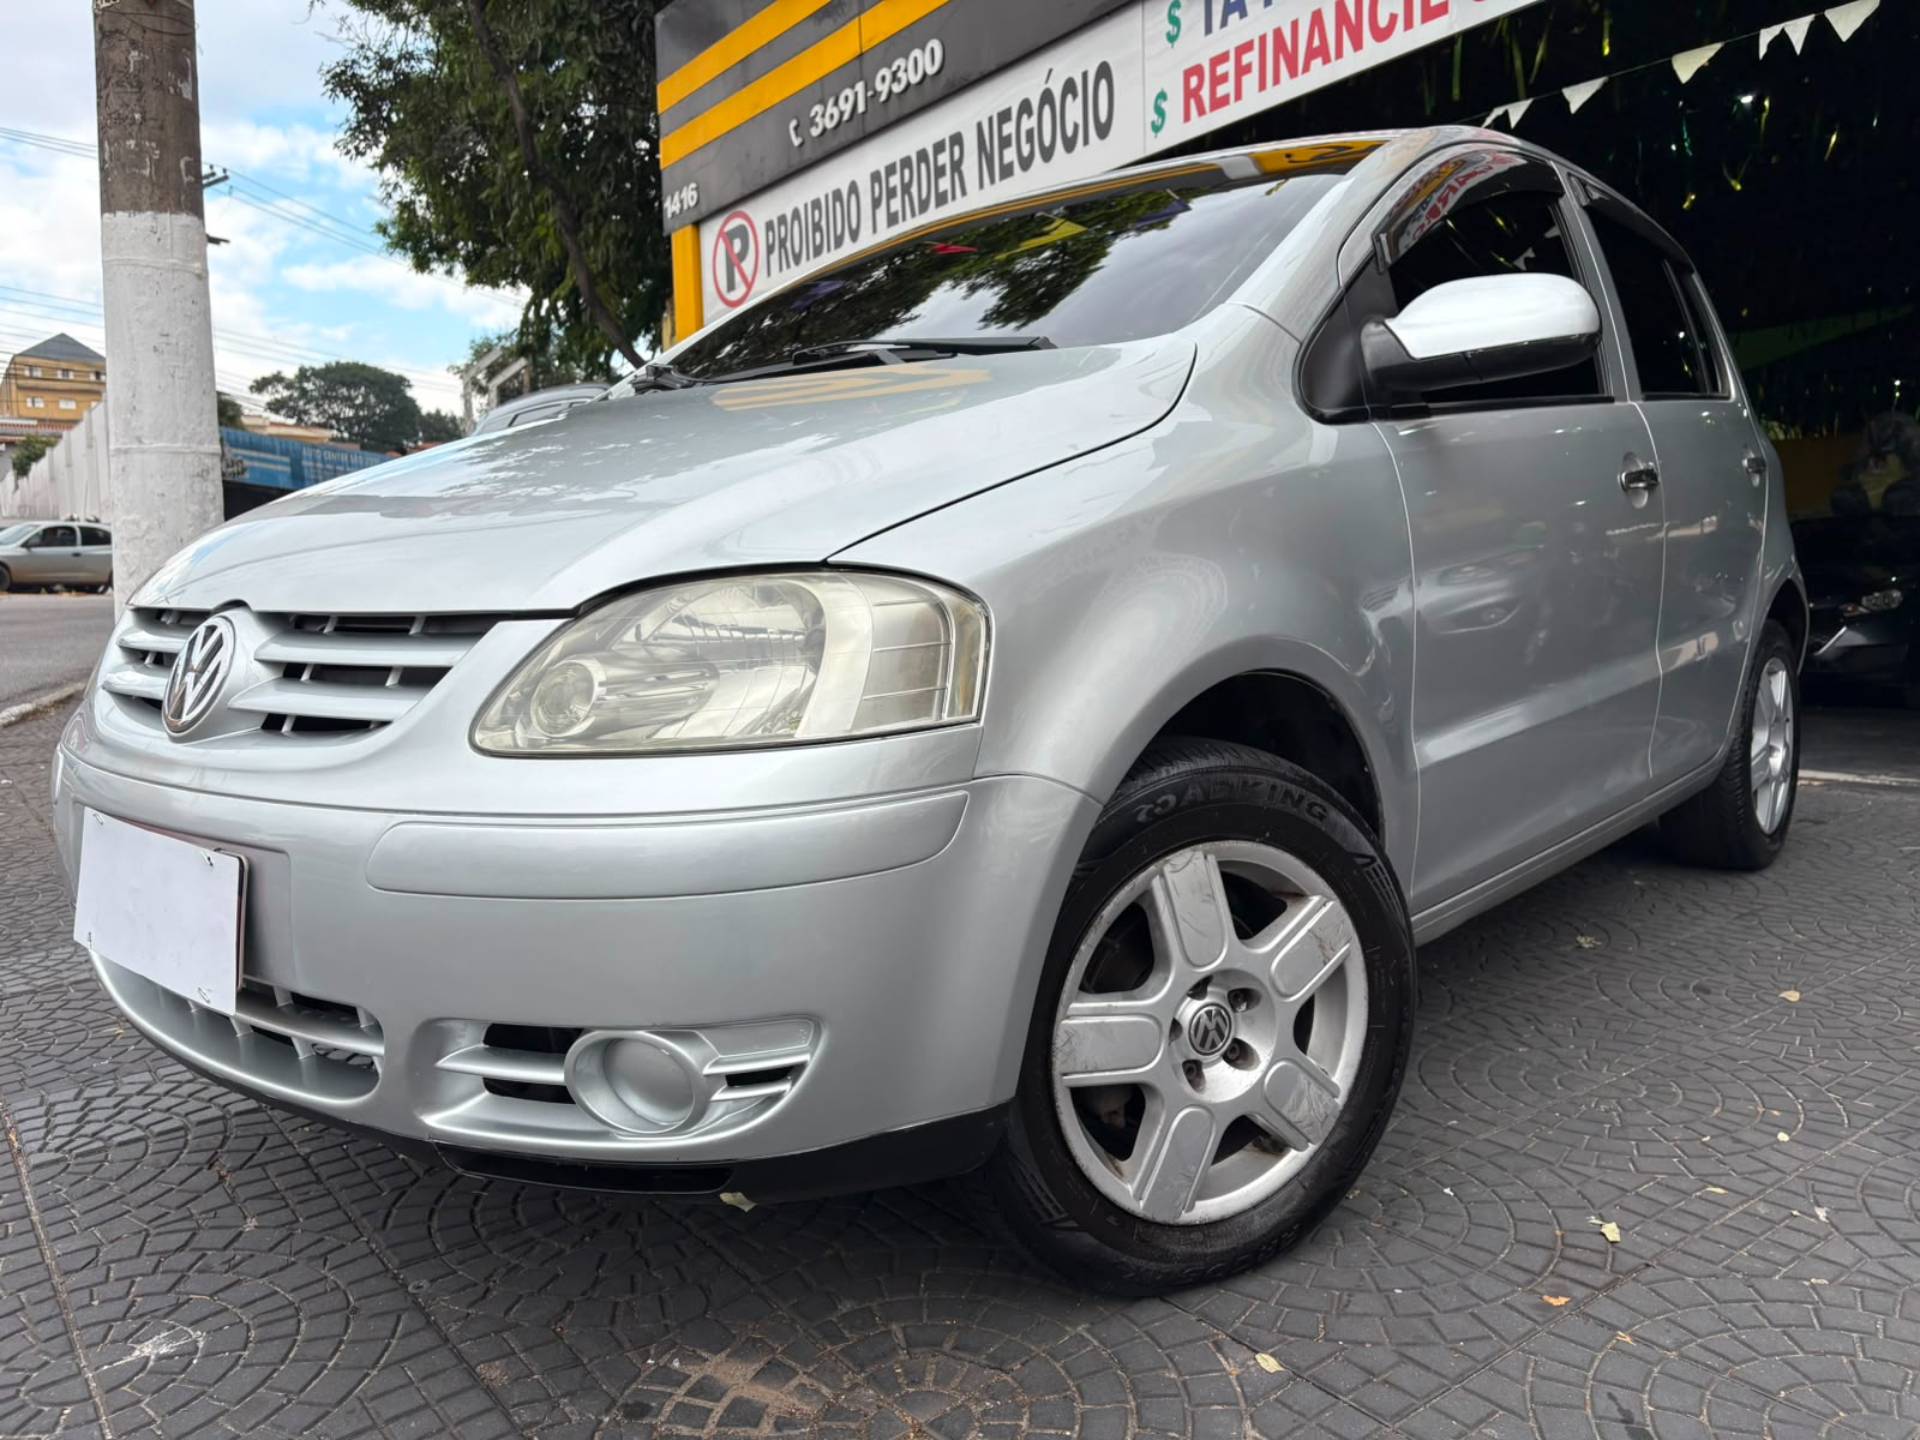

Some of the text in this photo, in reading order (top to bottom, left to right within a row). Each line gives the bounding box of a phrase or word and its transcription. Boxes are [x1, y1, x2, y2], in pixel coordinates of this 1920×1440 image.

[809, 38, 944, 138] 3691-9300
[663, 182, 698, 219] 1416
[765, 179, 861, 278] PROIBIDO
[870, 139, 968, 235] PERDER
[976, 60, 1114, 191] NEGÓCIO
